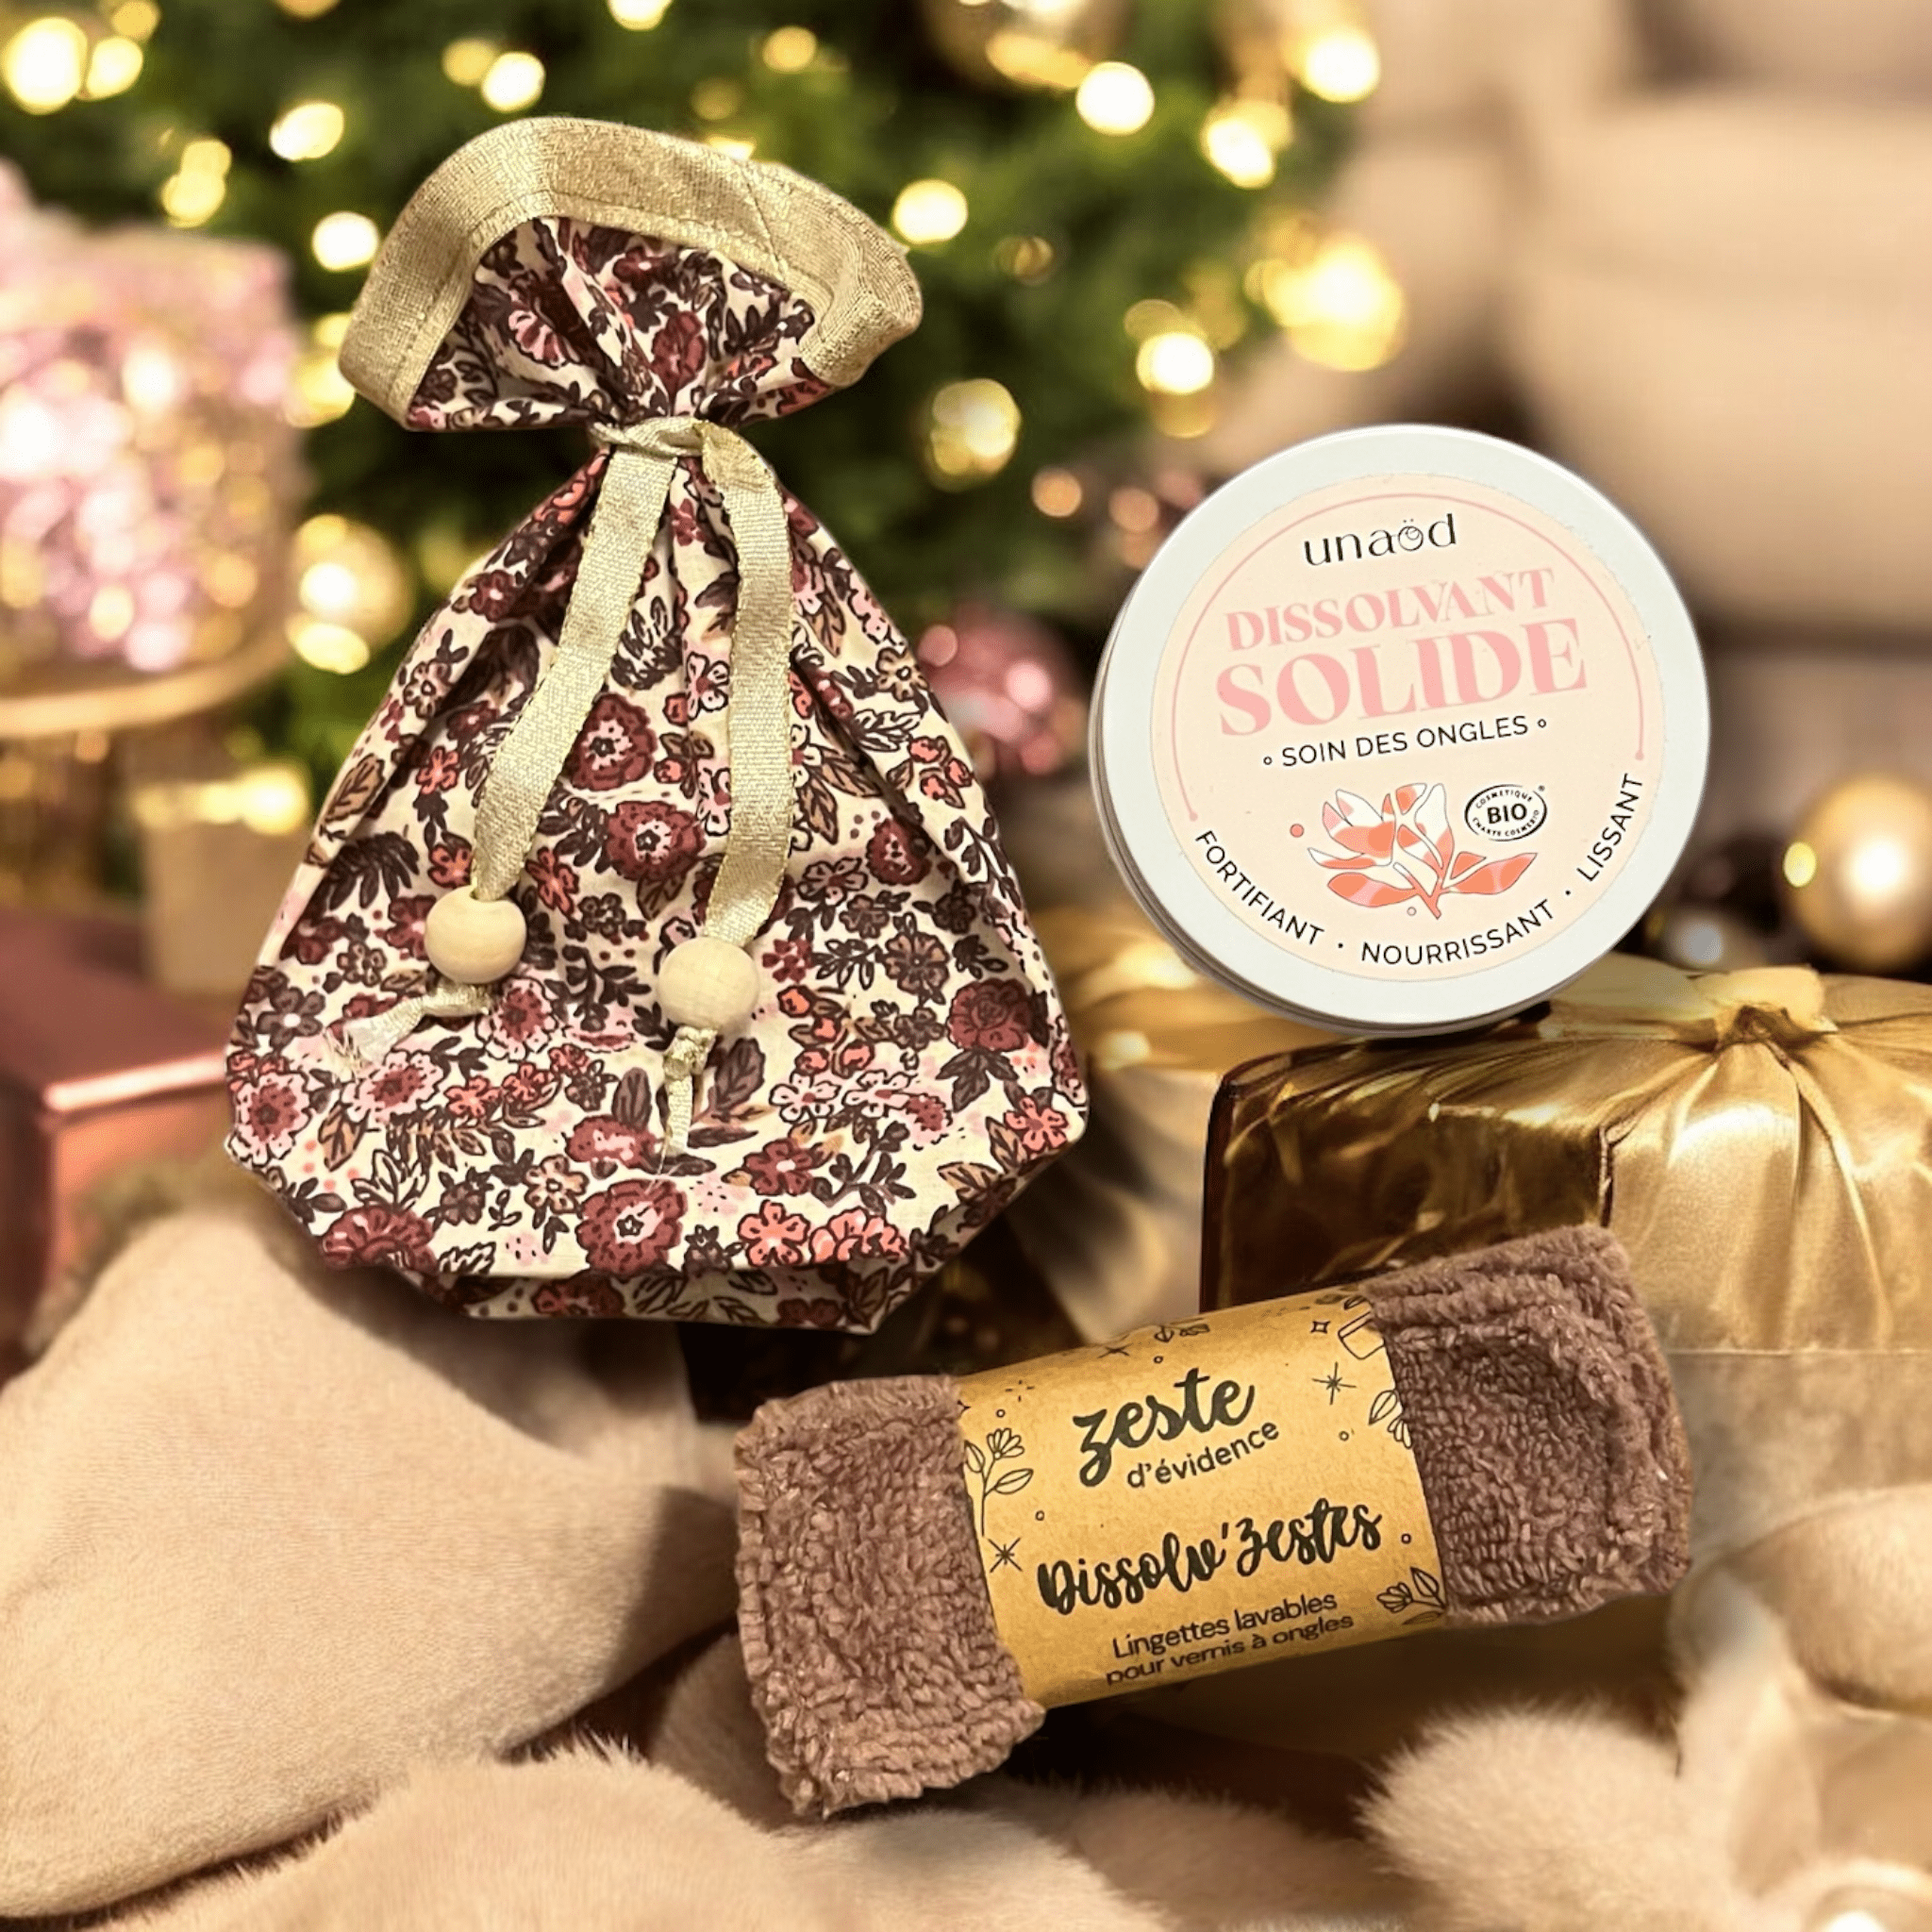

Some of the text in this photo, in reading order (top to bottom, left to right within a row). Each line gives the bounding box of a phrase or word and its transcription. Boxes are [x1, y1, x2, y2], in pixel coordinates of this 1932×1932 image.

[1226, 568, 1556, 651] DISSOLVANT
[1216, 618, 1588, 736] SOLIDE
[1281, 716, 1529, 767] SOIN DES ONGLES
[1487, 803, 1528, 824] BIO
[1195, 773, 1643, 965] FORTIFIANT NOURRISSANT LISSANT
[1106, 1615, 1355, 1686] pour vernis à ongles
[1112, 1593, 1338, 1659] Lingettes lavables
